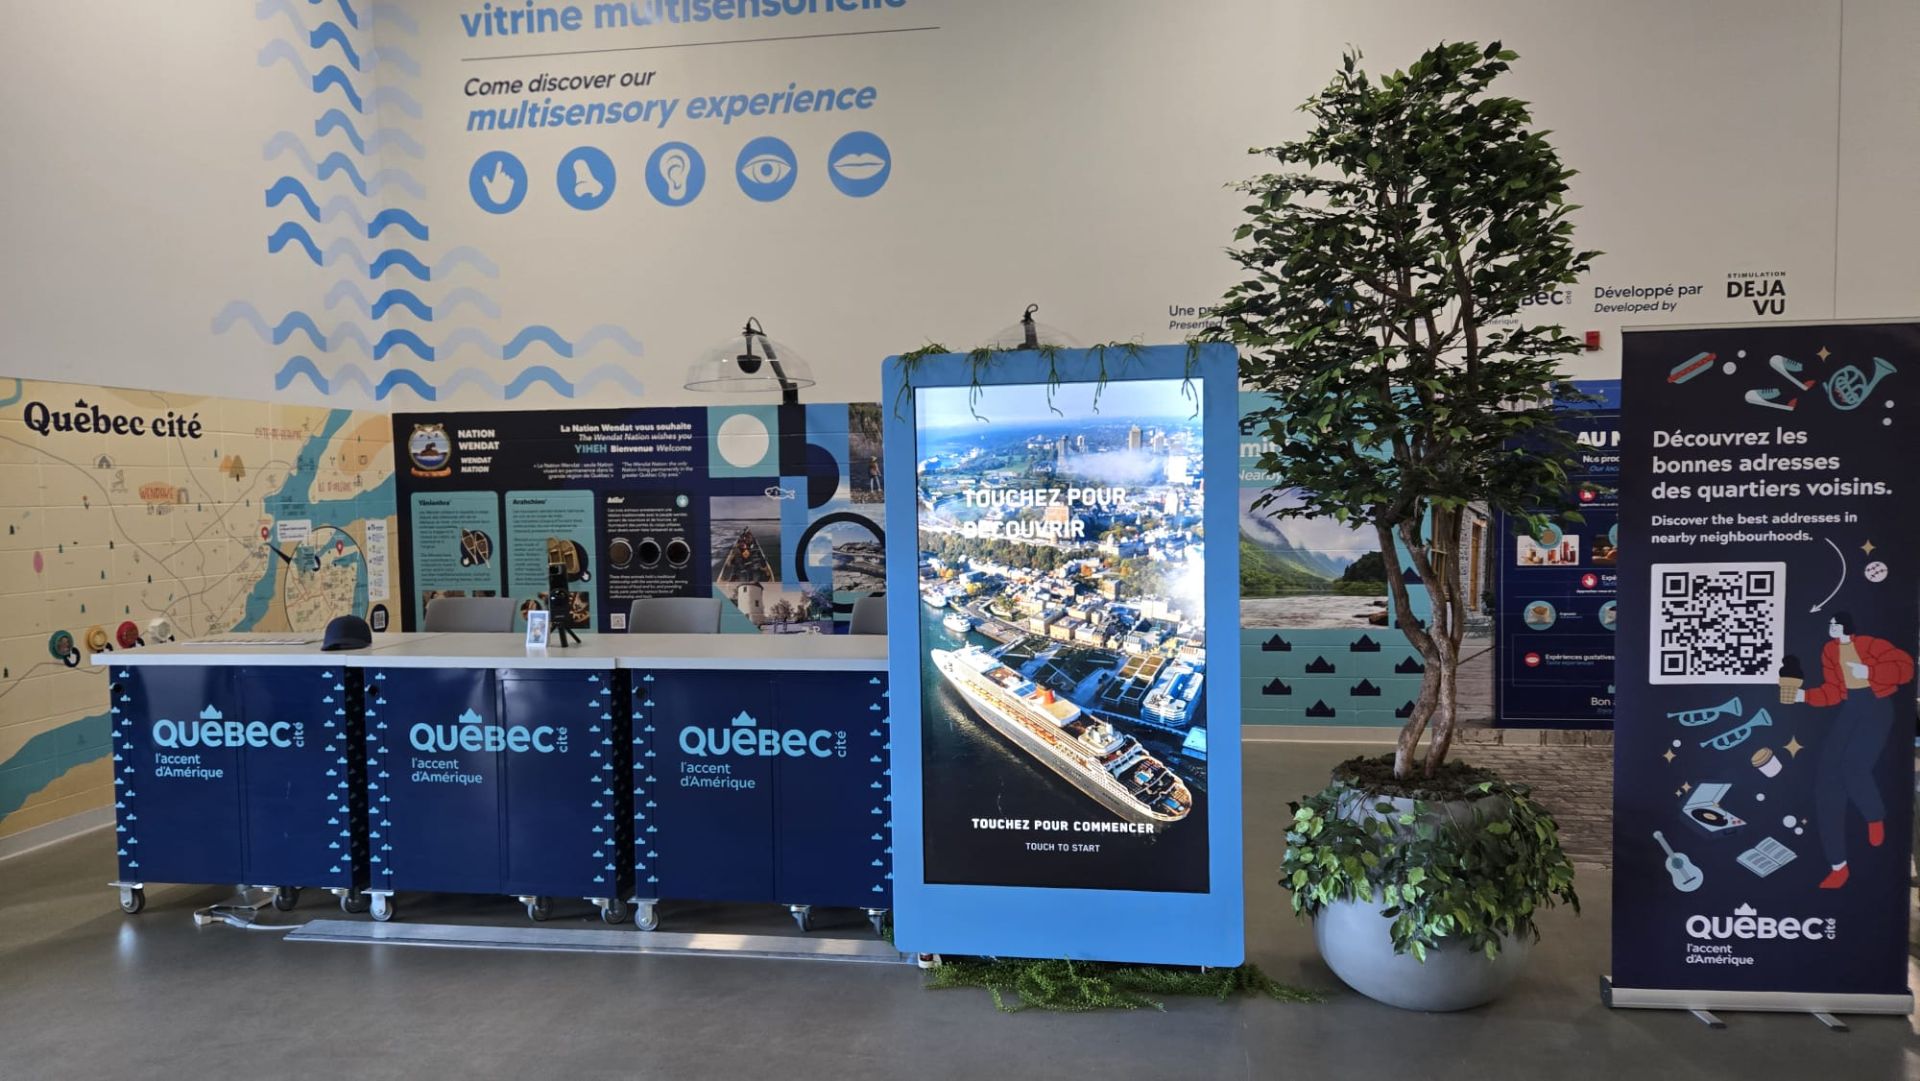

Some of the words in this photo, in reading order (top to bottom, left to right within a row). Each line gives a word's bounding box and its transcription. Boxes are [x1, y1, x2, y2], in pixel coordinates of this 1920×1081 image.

[460, 0, 583, 37] vitrine
[595, 0, 907, 29] multisenso
[464, 78, 523, 96] Come
[528, 73, 615, 92] discover
[620, 70, 656, 86] our
[467, 97, 680, 131] multisensory
[686, 82, 877, 125] experience
[1727, 271, 1786, 279] STIMULATION
[1594, 284, 1674, 299] Développé
[1678, 283, 1703, 298] par
[1727, 280, 1786, 298] DEJA
[1168, 305, 1195, 316] Une
[1594, 300, 1659, 314] Developed
[1662, 301, 1677, 312] by
[1753, 299, 1786, 316] VU
[152, 412, 203, 439] cité
[560, 424, 569, 432] La
[572, 424, 600, 432] Nation
[601, 423, 633, 431] Wendat
[656, 422, 692, 430] souhaite
[458, 429, 495, 438] NATION
[579, 433, 592, 441] The
[594, 433, 623, 441] Wendat
[651, 432, 676, 440] wishes
[678, 433, 693, 441] you
[1577, 431, 1607, 447] AU
[1653, 429, 1770, 448] Découvrez
[1776, 426, 1808, 445] les
[458, 441, 500, 450] WENDAT
[574, 444, 608, 453] YIHEH
[610, 445, 653, 453] Bienvenue
[656, 444, 692, 452] Welcome
[1652, 456, 1732, 474] bonnes
[1739, 453, 1840, 472] adresses
[1651, 481, 1691, 499] des
[1697, 479, 1801, 502] quartiers
[1806, 477, 1893, 496] voisins.
[963, 488, 1061, 508] TOUCHEZ
[1067, 487, 1127, 506] POUR
[1651, 514, 1708, 526] Discover
[1711, 513, 1734, 525] the
[1737, 513, 1768, 525] best
[1772, 512, 1841, 525] addresses
[1845, 511, 1858, 523] in
[1651, 532, 1697, 545] nearby
[1700, 530, 1813, 545] neighbourhoods.
[1591, 697, 1611, 706] Bon
[293, 721, 305, 748] cité
[556, 726, 568, 753] cité
[834, 730, 847, 758] cité
[155, 753, 201, 765] l'accent
[412, 757, 459, 770] l'accent
[155, 766, 224, 780] d'Amérique
[680, 761, 731, 774] l'accent
[411, 771, 483, 786] d'Amérique
[680, 776, 756, 791] d'Amérique
[971, 818, 1030, 830] TOUCHEZ
[1034, 820, 1069, 831] POUR
[1073, 821, 1155, 834] COMMENCER
[1025, 842, 1055, 851] TOUCH
[1058, 843, 1070, 851] TO
[1072, 843, 1101, 852] START
[1824, 918, 1836, 940] cité
[1687, 943, 1733, 954] l'accent
[1685, 954, 1755, 966] d'Amérique
